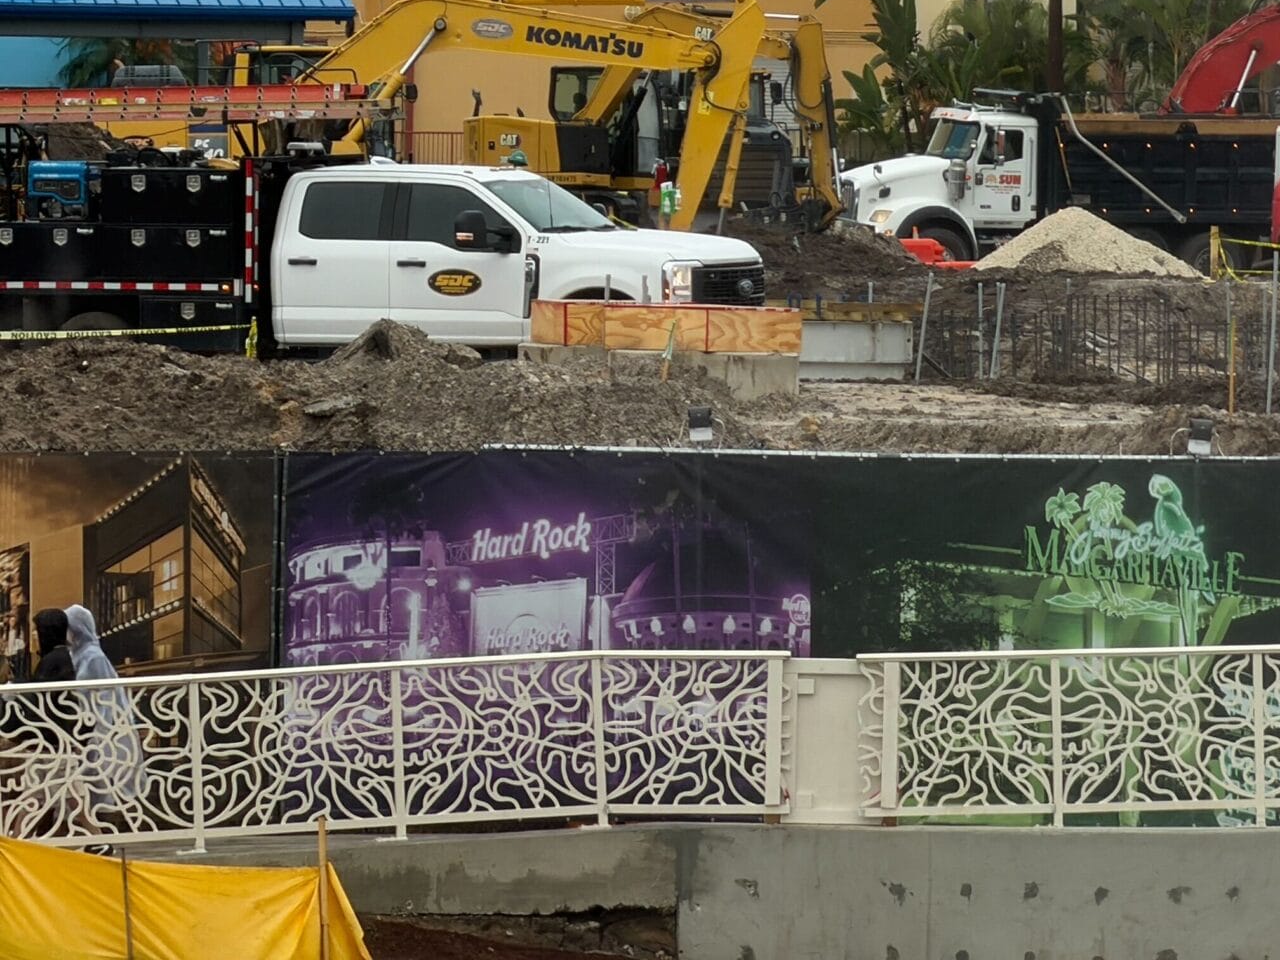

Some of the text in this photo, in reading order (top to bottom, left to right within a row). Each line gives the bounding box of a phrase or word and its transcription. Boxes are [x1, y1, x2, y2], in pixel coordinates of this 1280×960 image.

[694, 26, 713, 40] CAT
[526, 25, 644, 58] KOMATSU
[500, 133, 518, 146] CAT
[999, 174, 1022, 185] SUN
[434, 274, 475, 287] SDC
[472, 512, 591, 561] Hard Rock
